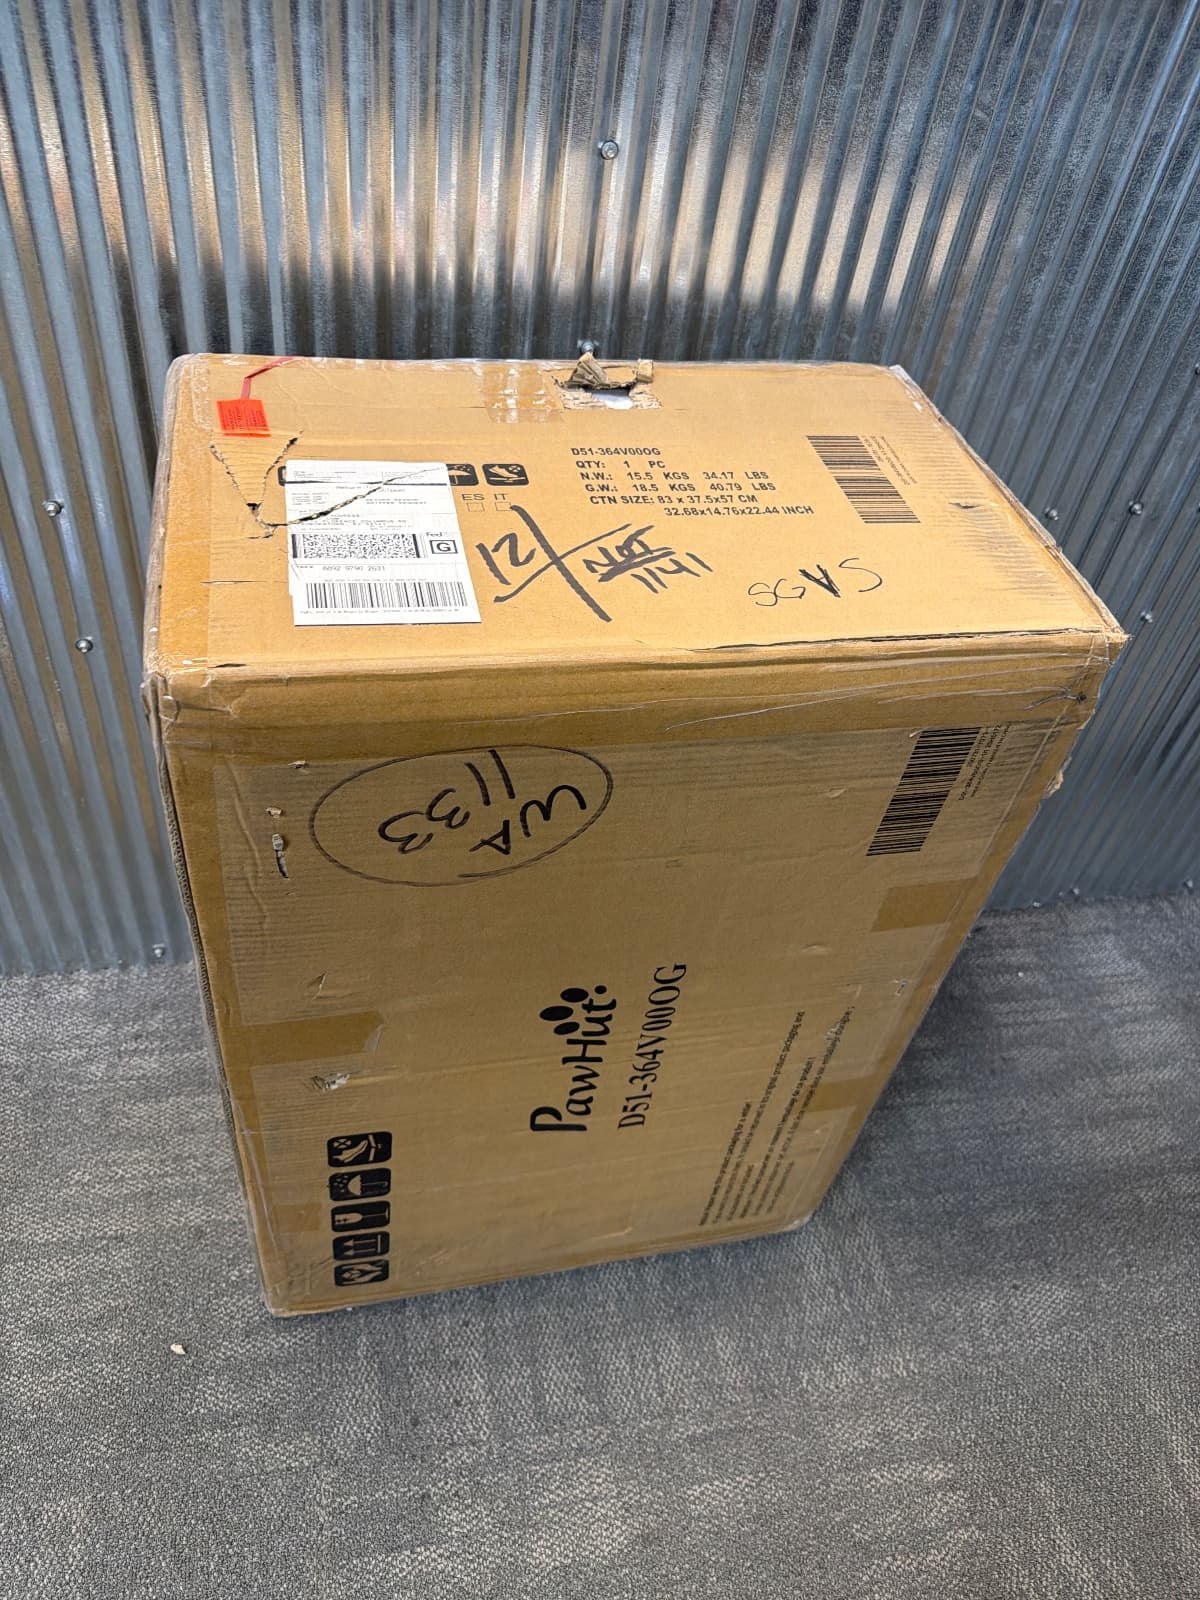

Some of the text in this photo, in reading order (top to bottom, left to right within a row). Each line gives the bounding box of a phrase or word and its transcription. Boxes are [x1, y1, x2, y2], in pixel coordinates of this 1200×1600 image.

[575, 460, 666, 469] QTY: 1 PC
[580, 471, 769, 480] N.W.: 15.5 KGS 34.17 LBS
[585, 482, 776, 492] G.W.: 18.5 KGS 40.79 LBS
[462, 493, 507, 501] ES IT
[590, 495, 618, 504] CTN
[620, 495, 655, 504] SIZE:
[657, 495, 673, 503] 83
[738, 494, 758, 503] CM
[664, 505, 814, 516] 32.68x14.76x22.44 INCH
[436, 542, 452, 552] G
[530, 997, 617, 1132] PawHut
